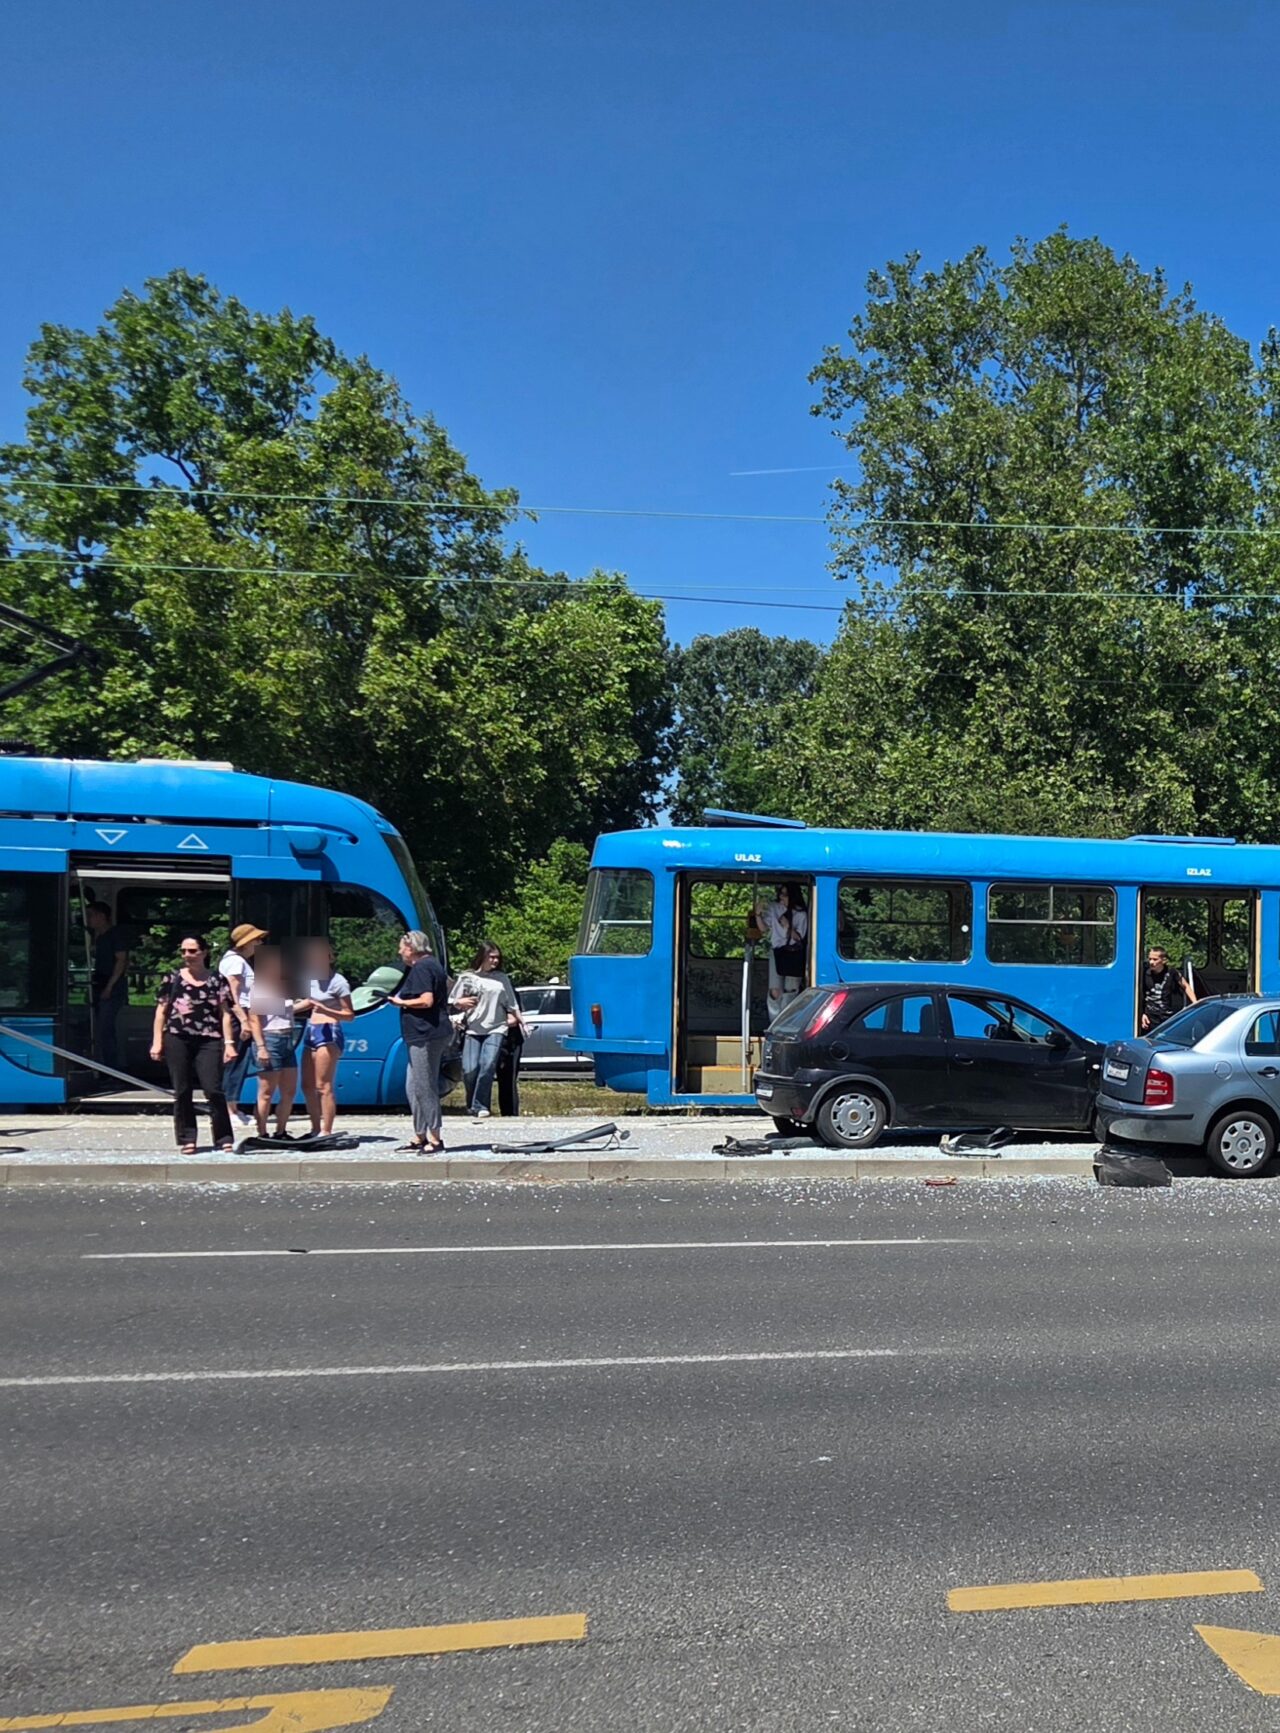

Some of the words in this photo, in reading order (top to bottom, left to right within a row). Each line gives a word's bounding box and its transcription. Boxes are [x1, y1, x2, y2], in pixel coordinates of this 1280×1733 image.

[734, 853, 762, 862] ULAZ
[1186, 867, 1212, 877] IZLAZ
[344, 1039, 369, 1053] 73
